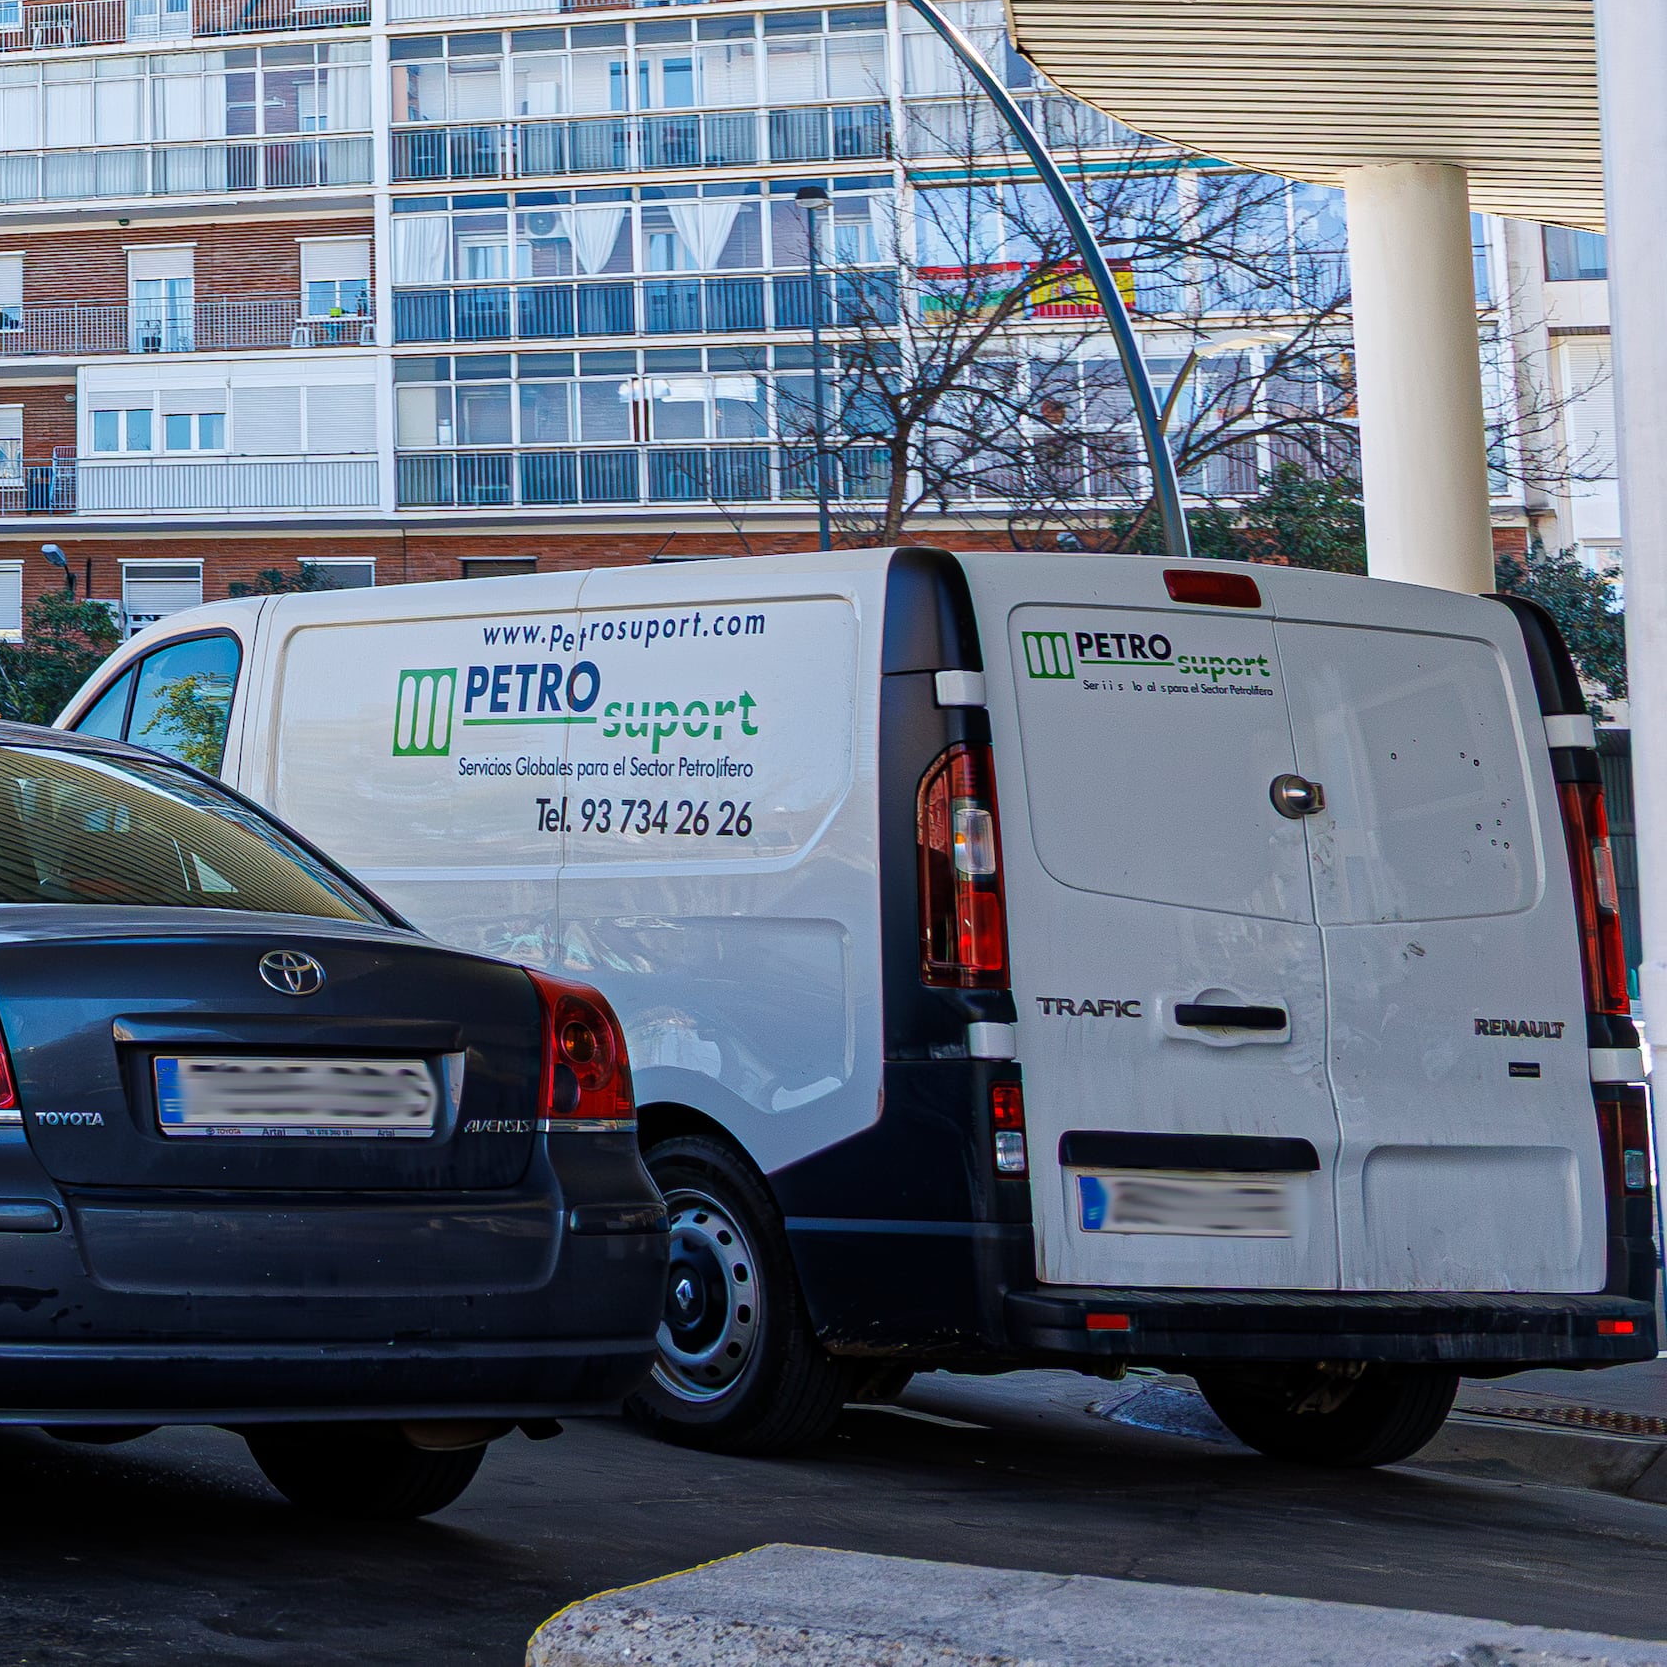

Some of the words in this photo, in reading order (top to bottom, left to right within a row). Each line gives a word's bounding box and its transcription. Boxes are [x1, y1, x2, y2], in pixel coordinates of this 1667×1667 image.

[483, 611, 766, 653] www.petrosuport.com
[1075, 632, 1172, 660] PETRO
[1177, 654, 1271, 682] suport
[464, 661, 601, 713] PETRO
[1168, 685, 1189, 695] para
[1190, 684, 1200, 693] el
[1201, 684, 1228, 695] Sector
[1229, 685, 1273, 696] Petrolífero
[603, 689, 759, 754] suport
[458, 756, 512, 778] Servicios
[515, 756, 574, 777] Globales
[577, 761, 609, 781] para
[613, 756, 626, 776] el
[629, 756, 675, 777] Sector
[678, 755, 754, 779] Petrolífero
[536, 798, 572, 833] Tel.
[580, 798, 612, 834] 93
[620, 799, 668, 834] 734
[676, 800, 710, 836] 26
[717, 800, 753, 837] 26
[1036, 997, 1142, 1018] TRAFIC
[1474, 1019, 1565, 1038] RENAULT
[35, 1112, 105, 1126] TOYOTA
[217, 1127, 242, 1135] TOYOTA
[464, 1119, 531, 1133] AVENSIS
